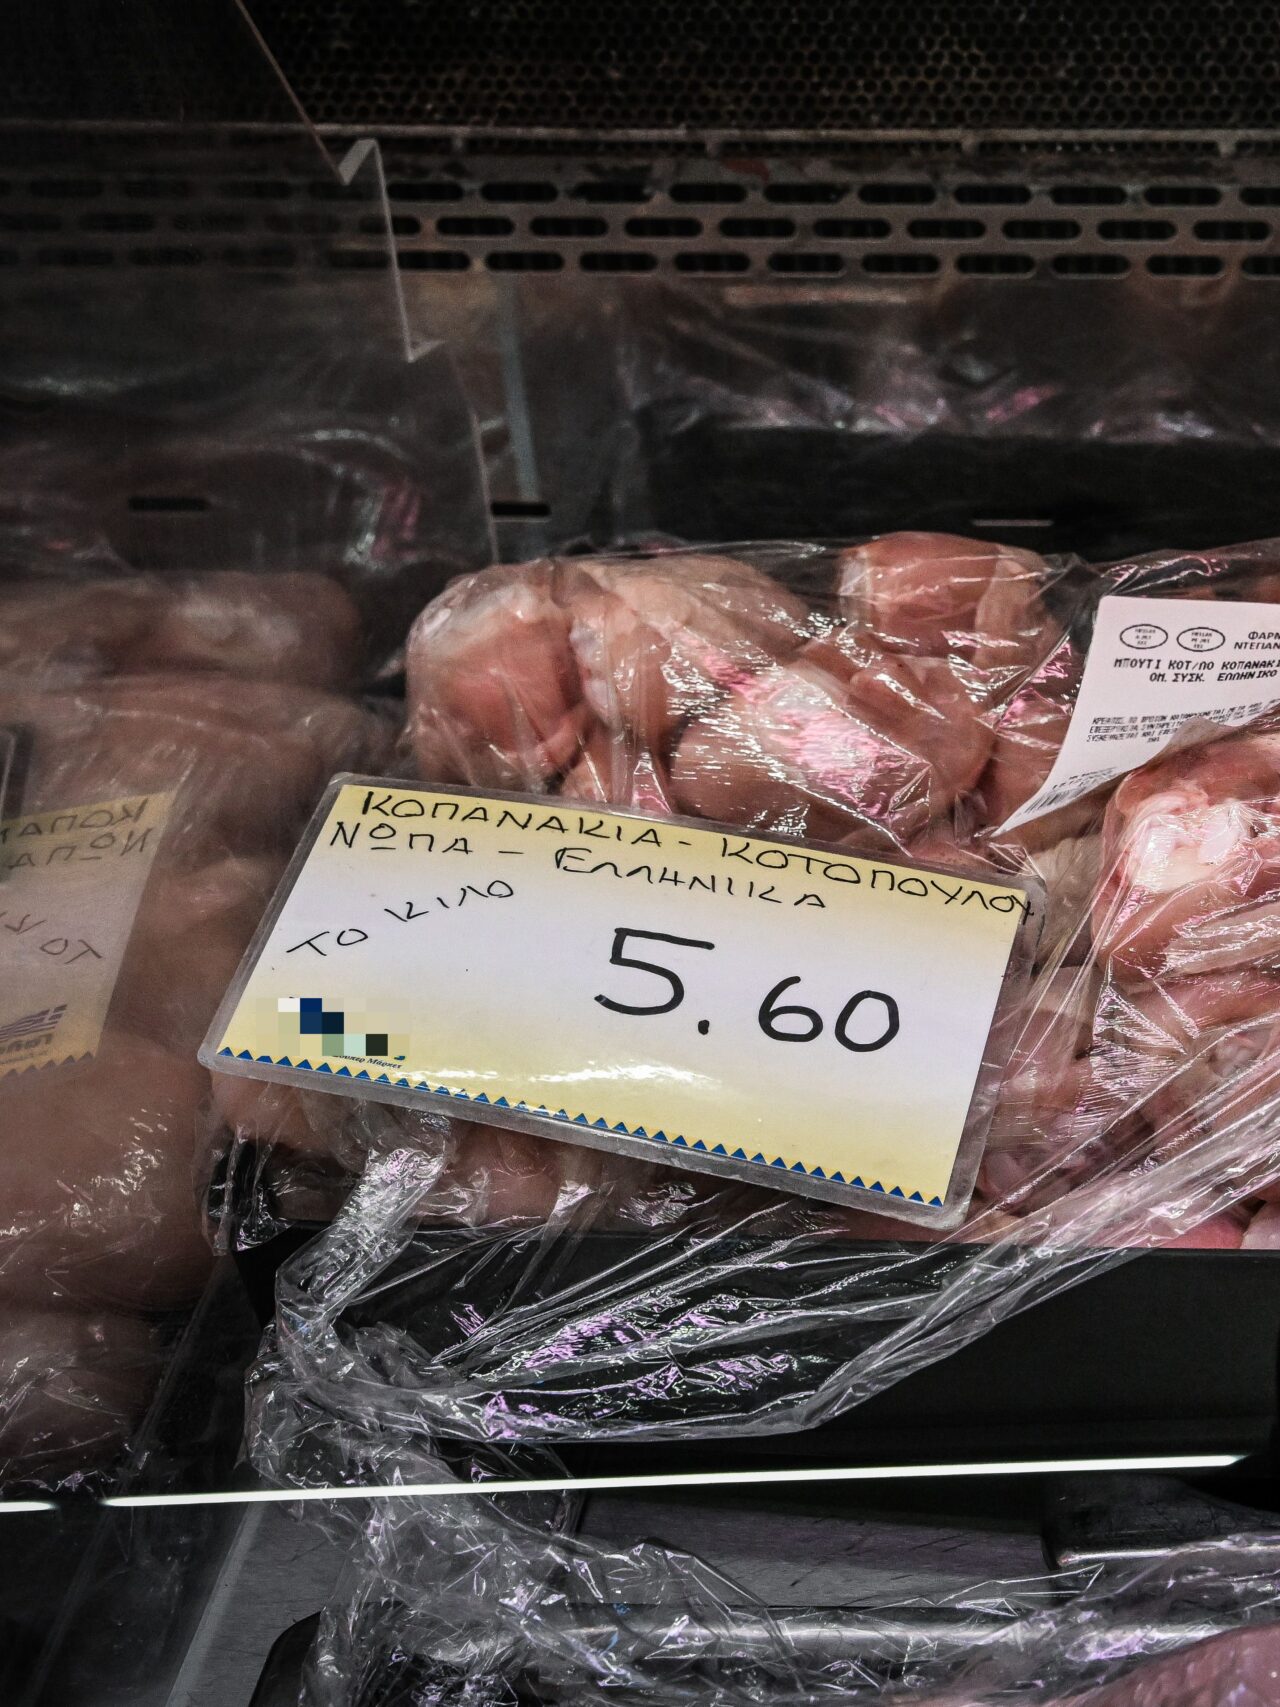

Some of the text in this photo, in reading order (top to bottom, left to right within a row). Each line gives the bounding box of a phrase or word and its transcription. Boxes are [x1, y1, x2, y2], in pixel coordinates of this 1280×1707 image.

[1114, 658, 1160, 669] ΜΠΟΥΤΙ
[1172, 673, 1205, 682] ΣΥΣΚ.
[1217, 669, 1278, 682] ΕΛΛΗΝΙΚΟ
[362, 791, 663, 847] ΚΟΠΑΝΑΚΙΑ
[328, 821, 473, 854] ΝΩΠΑ
[554, 848, 827, 908] ΕΛΛΗΝΙΚΑ
[286, 879, 515, 957] ΤΟ ΚΙΛΟ
[594, 927, 901, 1054] 5.60
